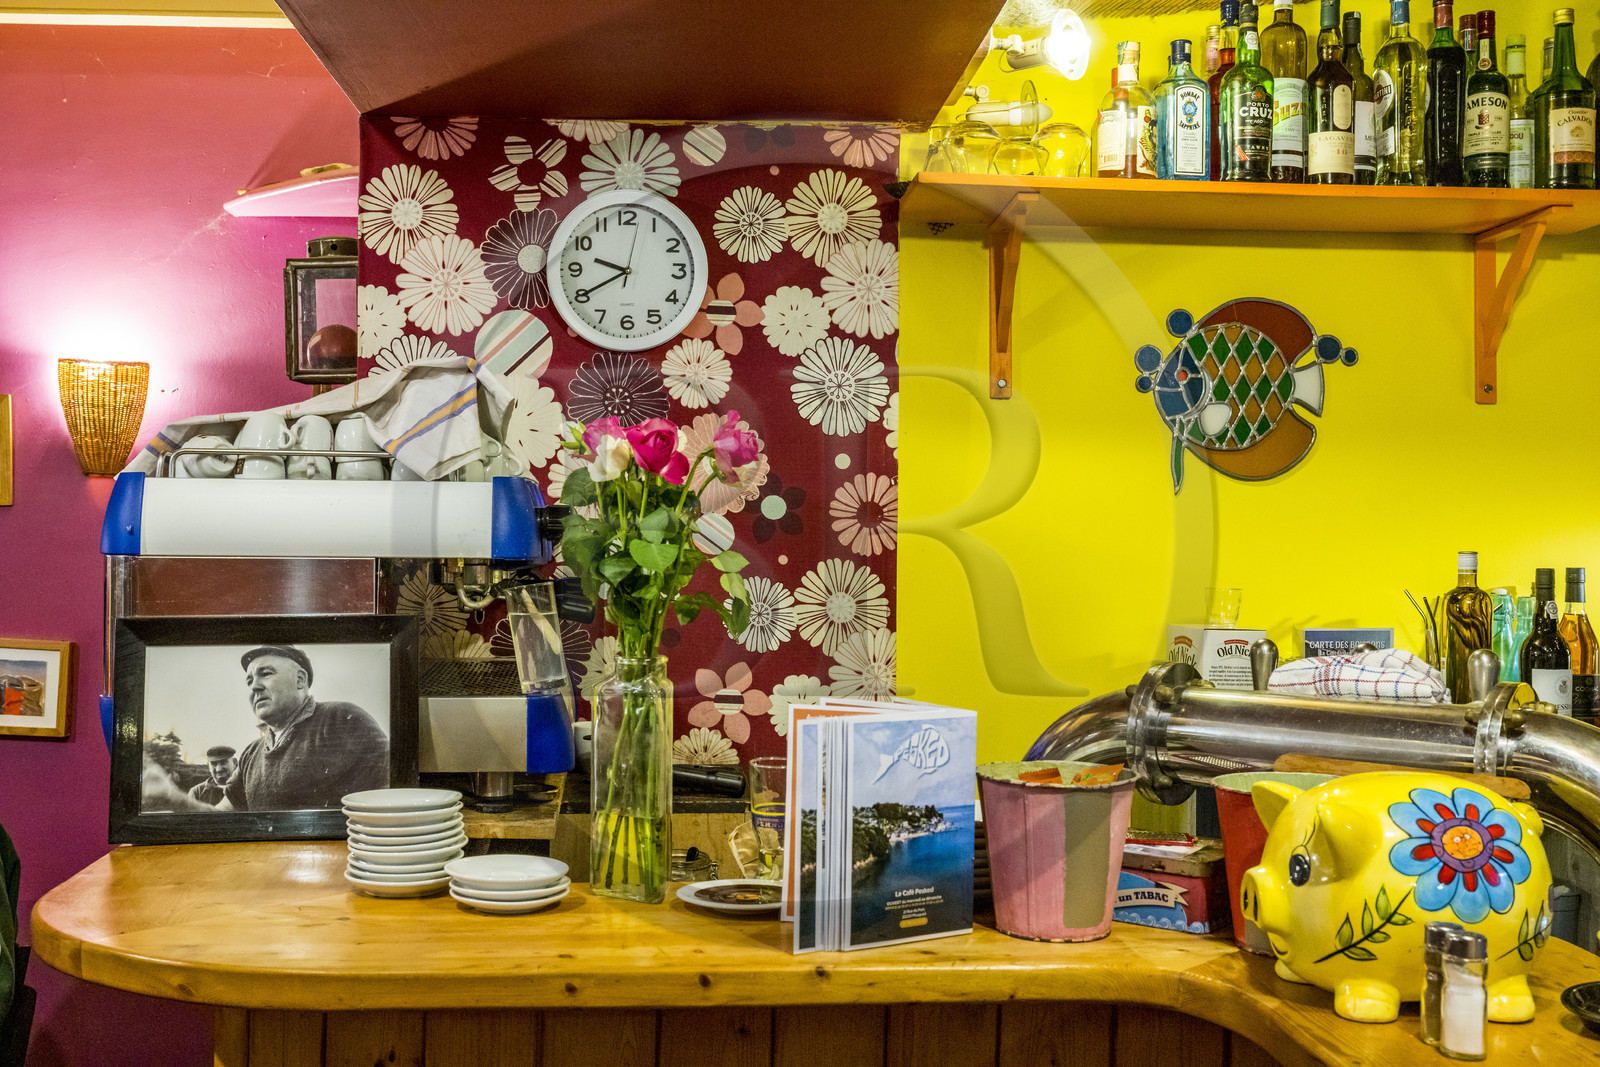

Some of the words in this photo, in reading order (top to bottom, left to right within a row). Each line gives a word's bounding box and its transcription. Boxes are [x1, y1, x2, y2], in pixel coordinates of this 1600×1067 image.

[1180, 91, 1200, 102] BOMBAY
[1466, 96, 1508, 111] AMESON
[1239, 106, 1273, 120] CRUZ
[595, 217, 607, 233] 11
[617, 210, 638, 226] 12
[652, 217, 656, 233] 1
[575, 235, 592, 251] 10
[665, 237, 680, 253] 2
[568, 261, 583, 278] 9
[670, 262, 687, 280] 3
[574, 288, 591, 304] 8
[665, 289, 679, 305] 4
[594, 309, 607, 324] 7
[620, 315, 635, 331] 6
[646, 309, 662, 325] 5
[1216, 645, 1233, 658] Old
[1234, 644, 1251, 657] Nic
[1309, 640, 1334, 649] CARTE
[1335, 640, 1349, 649] DES
[1118, 893, 1132, 902] un
[1133, 891, 1169, 903] TABAC
